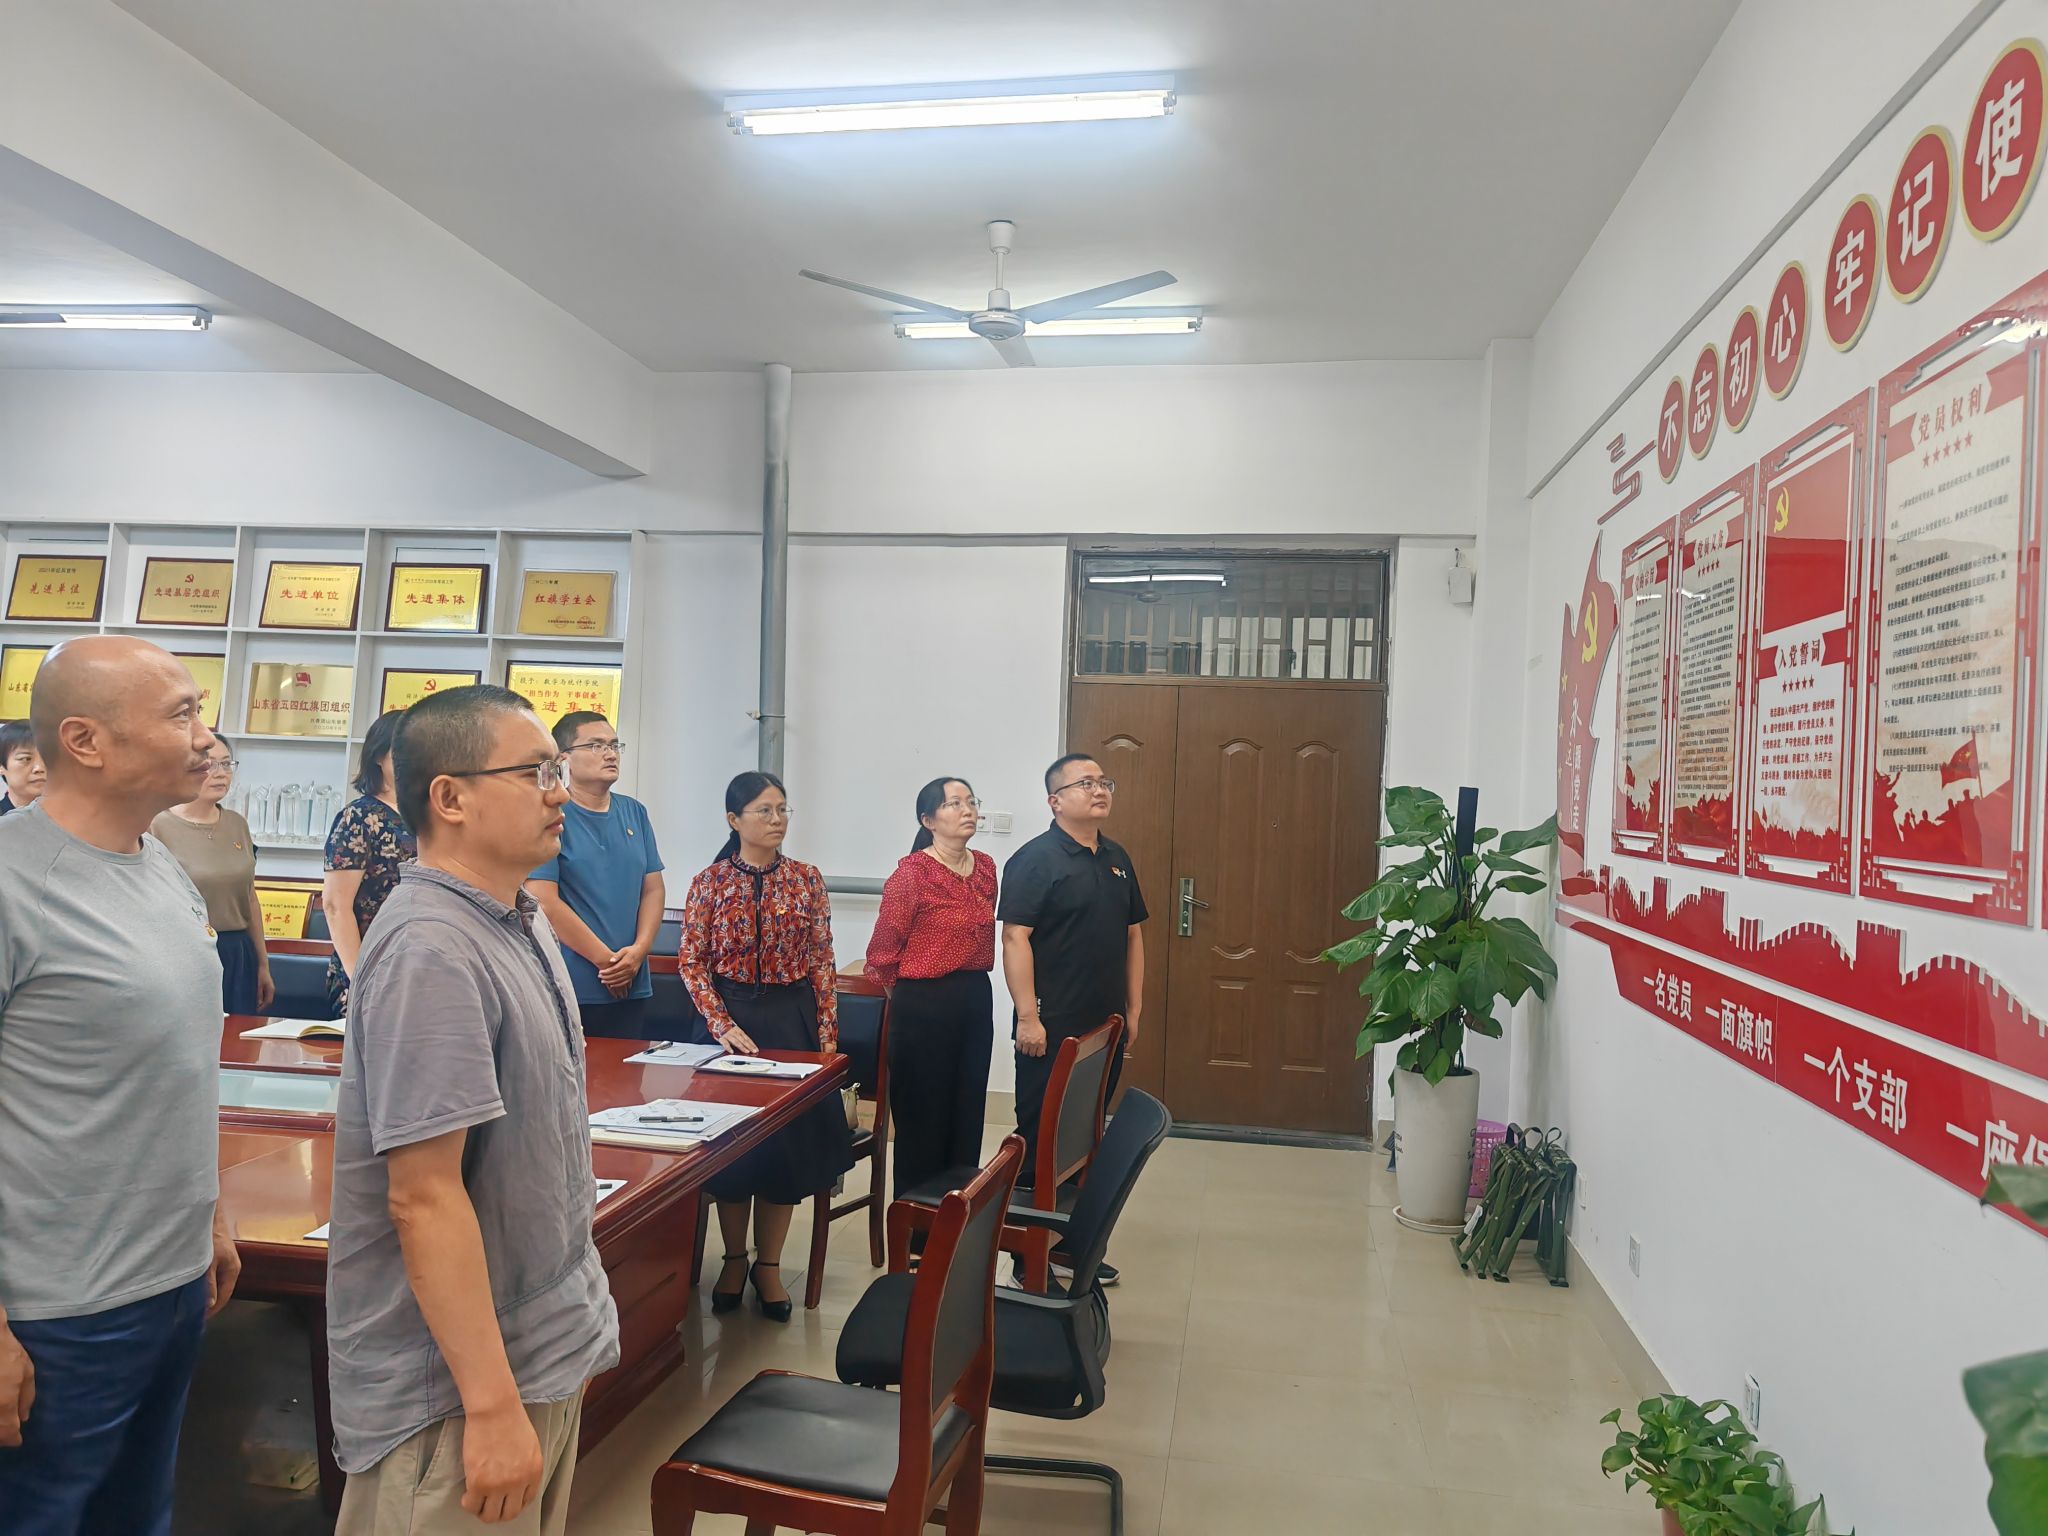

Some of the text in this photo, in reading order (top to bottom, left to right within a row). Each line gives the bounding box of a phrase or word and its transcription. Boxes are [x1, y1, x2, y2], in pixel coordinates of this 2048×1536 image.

[1661, 78, 2025, 458] 不忘初心 牢记使
[1918, 383, 1983, 444] 党员权利
[30, 582, 80, 595] 先进单位
[154, 586, 220, 598] 先进基层党组织
[280, 588, 339, 600] 先进单位
[405, 592, 465, 605] 先进集体
[535, 593, 597, 606] 红旗学生会
[1778, 638, 1821, 670] 入党誓词
[543, 678, 600, 687] 数学与统计学院
[252, 699, 350, 713] 山东省五四红旗团组织
[265, 912, 291, 924] 第一名
[1643, 967, 1693, 1022] 一名党员
[1705, 998, 1773, 1064] 一面旗帜
[1803, 1046, 1908, 1135] 一个支部
